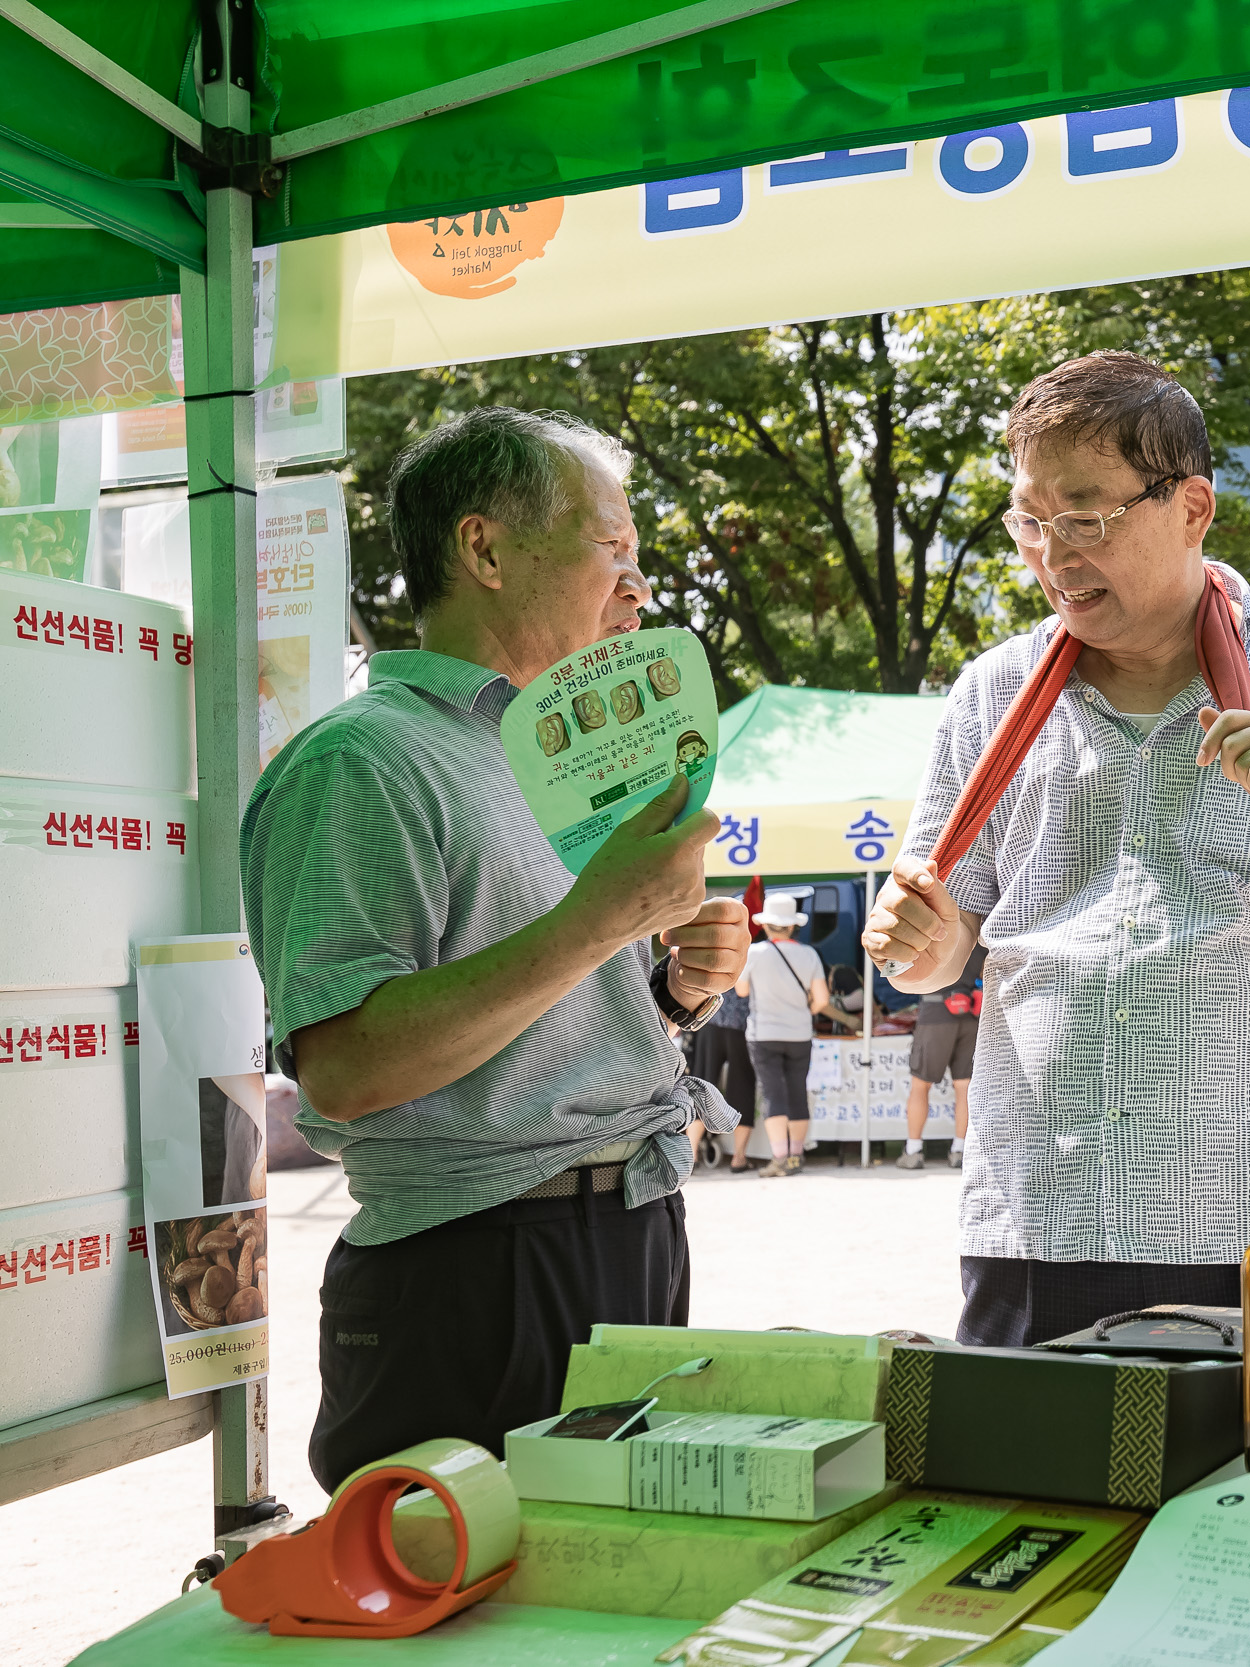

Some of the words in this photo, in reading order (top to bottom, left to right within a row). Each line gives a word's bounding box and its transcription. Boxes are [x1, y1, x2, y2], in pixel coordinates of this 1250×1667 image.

[13, 605, 123, 653] 신선식품!
[139, 627, 159, 661] 꼭
[536, 691, 564, 714] 30년
[564, 663, 613, 695] 건강나이
[616, 647, 669, 671] 준비하세요.
[550, 663, 575, 686] 3분
[586, 764, 615, 782] 거울과
[618, 753, 639, 770] 같은
[43, 812, 151, 851] 신선식품!
[166, 822, 187, 855] 꼭
[715, 815, 759, 866] 청
[845, 810, 894, 862] 송
